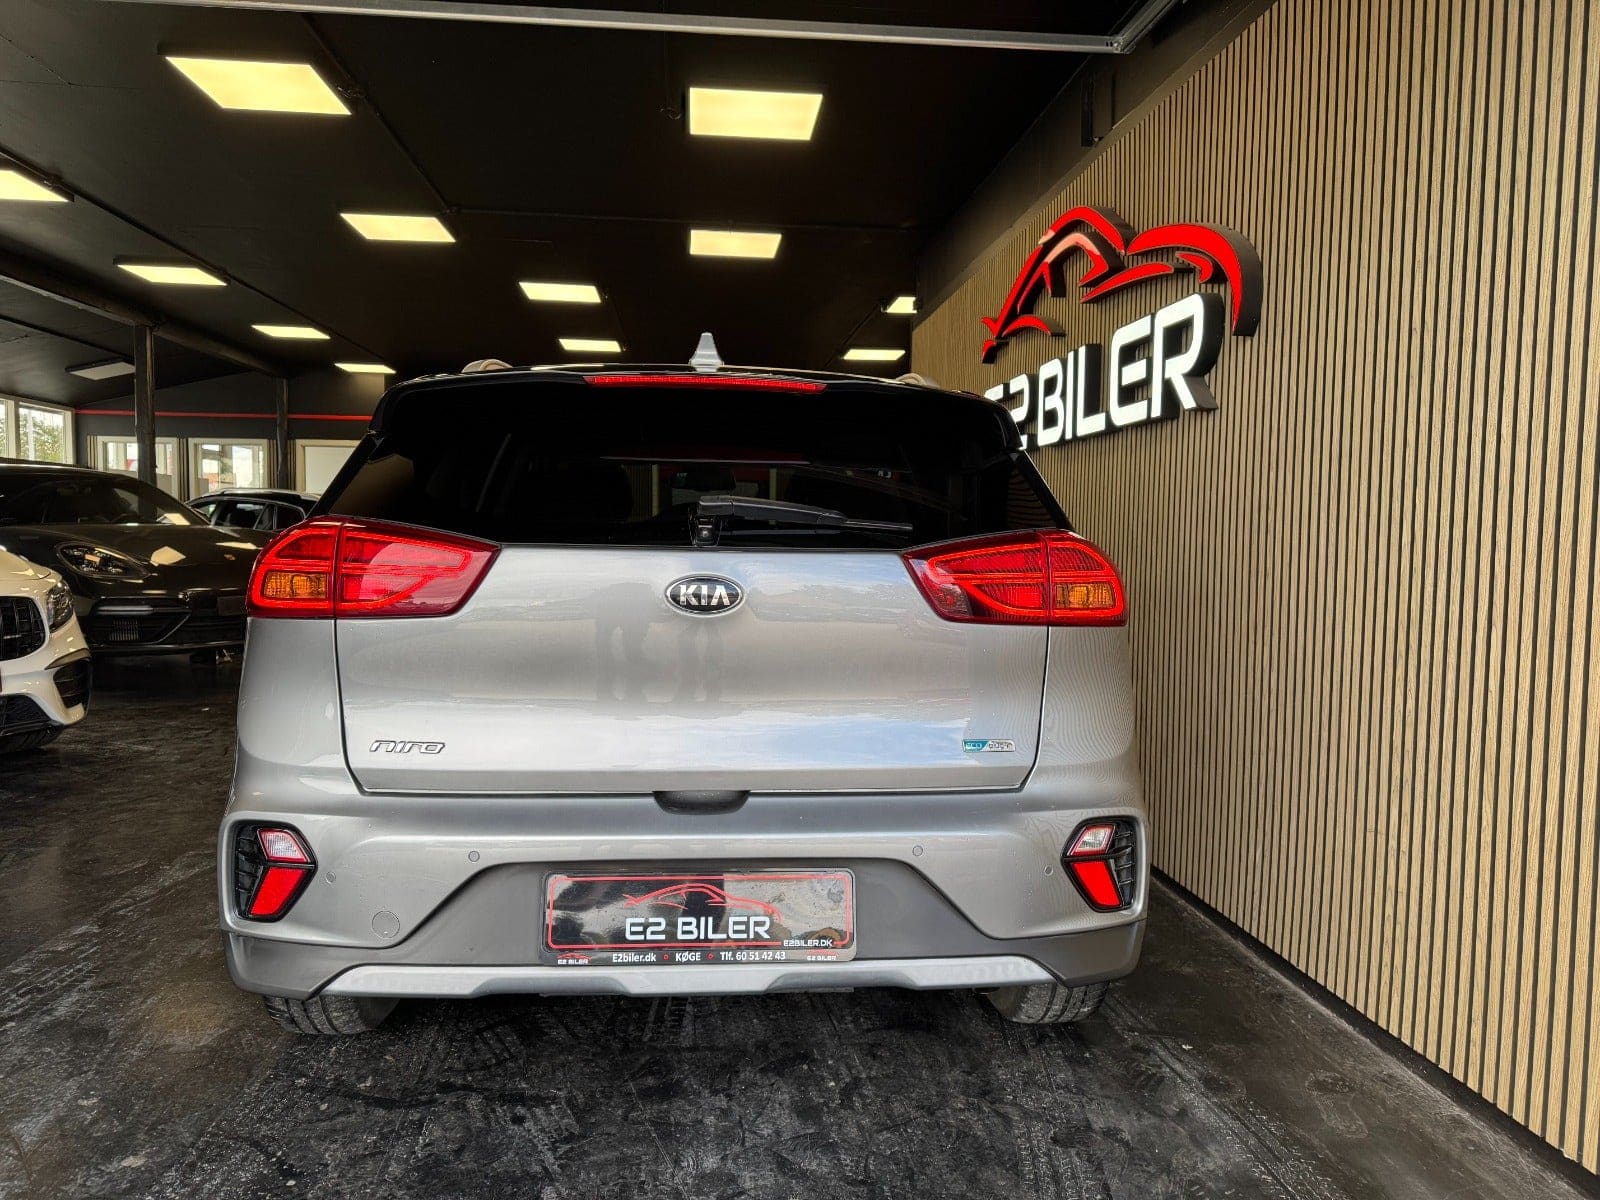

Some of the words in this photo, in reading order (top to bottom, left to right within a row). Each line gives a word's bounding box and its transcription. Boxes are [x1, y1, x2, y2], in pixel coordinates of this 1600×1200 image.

[1036, 293, 1205, 448] BILER
[680, 584, 730, 606] KIA
[625, 917, 666, 941] E2
[677, 916, 771, 940] BILER
[783, 939, 833, 947] E2BILER.DK
[612, 952, 657, 963] E2biler.dk
[675, 951, 701, 963] KØGE
[736, 951, 747, 961] 60
[749, 951, 760, 961] 51
[761, 951, 773, 961] 42
[775, 951, 786, 961] 43
